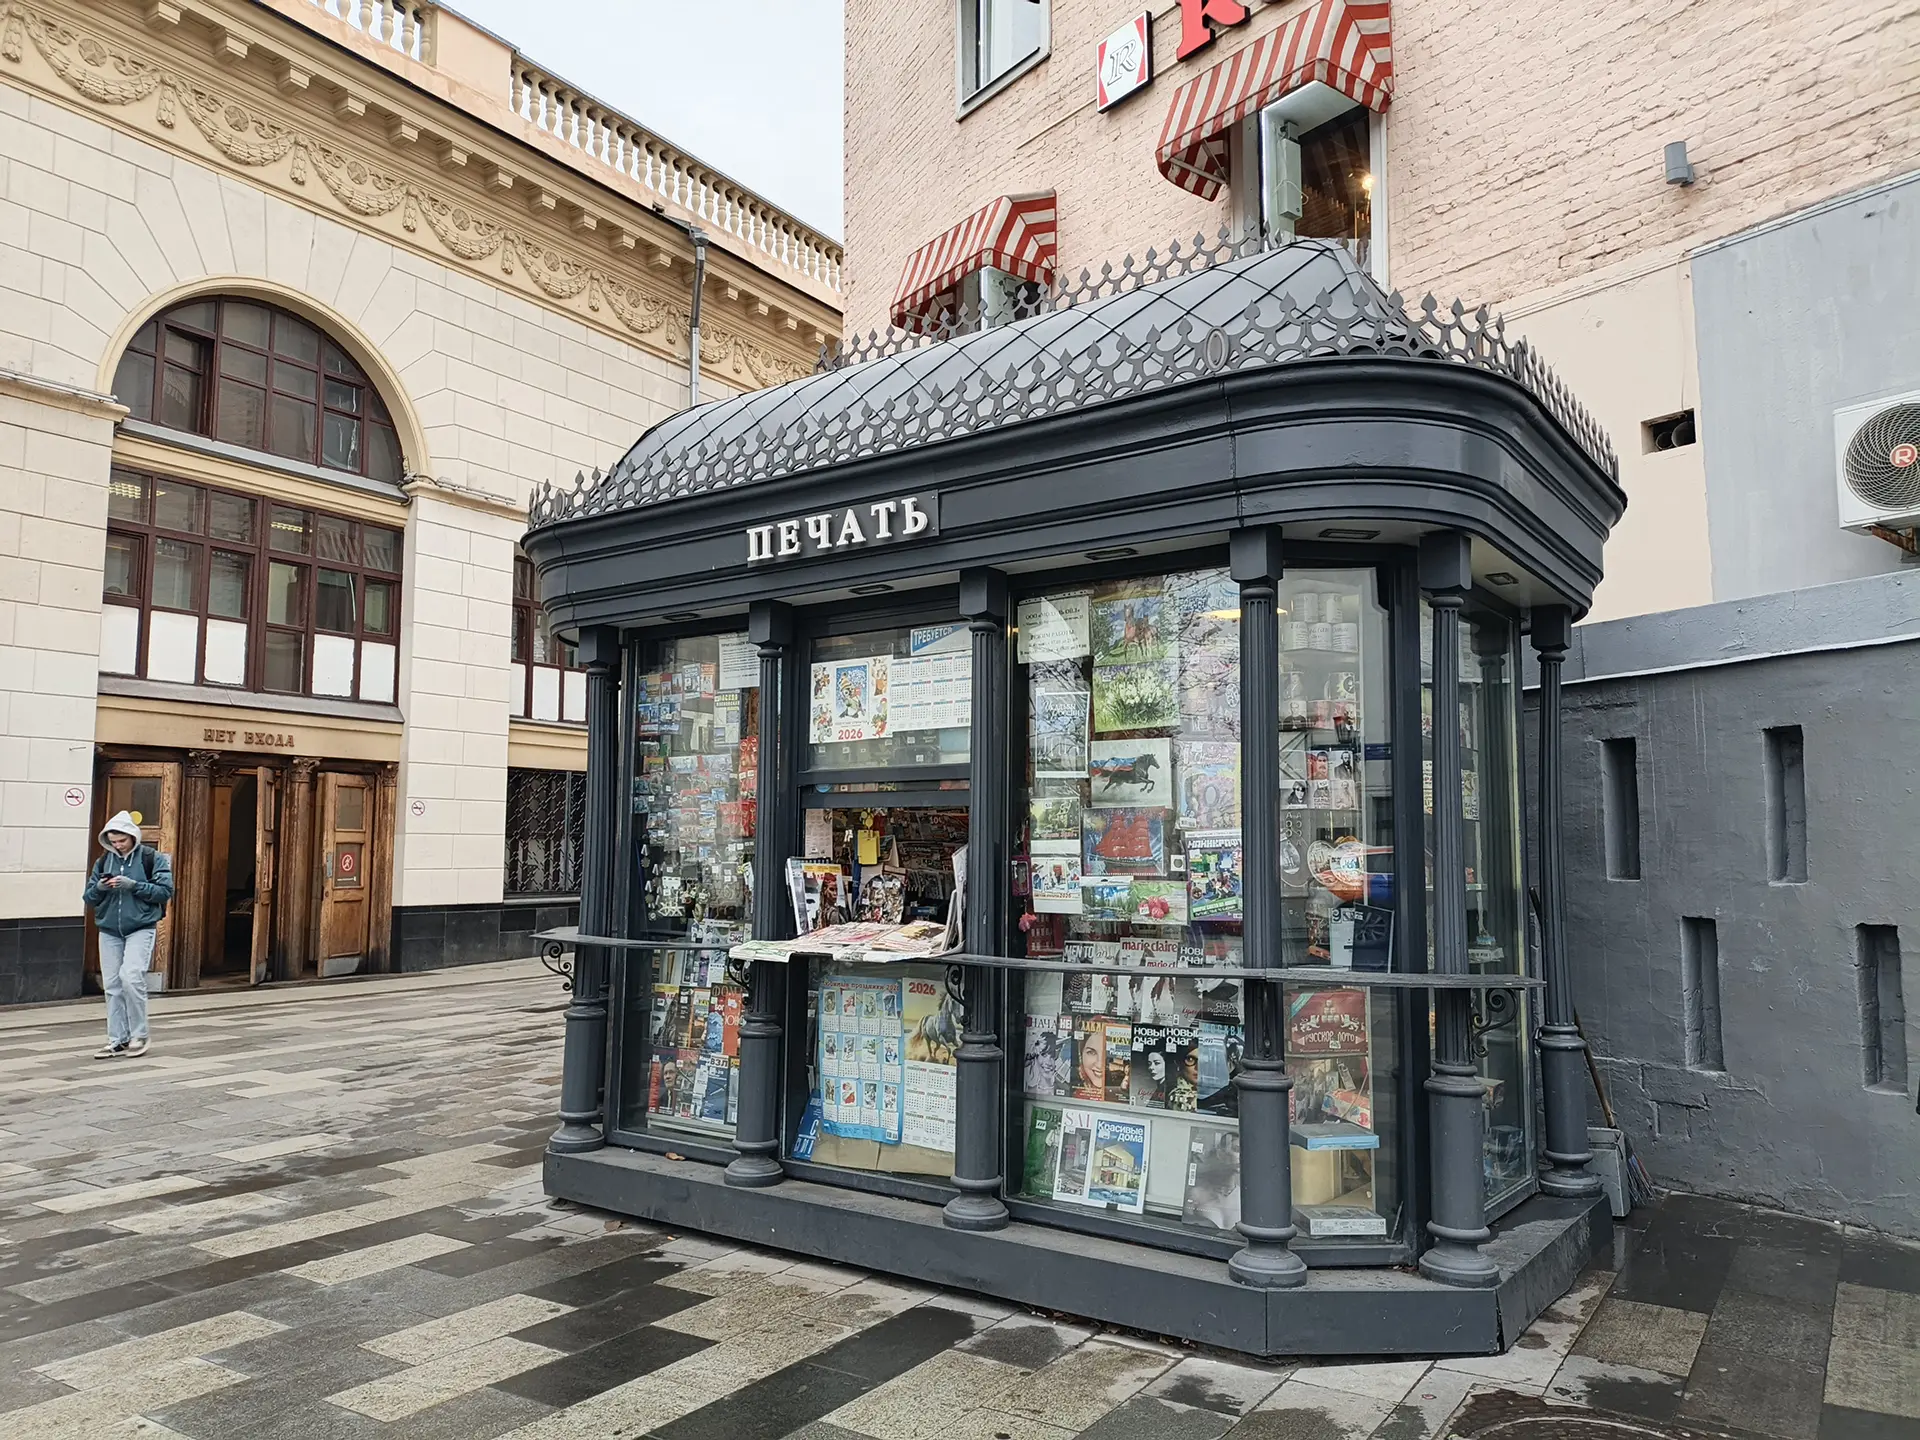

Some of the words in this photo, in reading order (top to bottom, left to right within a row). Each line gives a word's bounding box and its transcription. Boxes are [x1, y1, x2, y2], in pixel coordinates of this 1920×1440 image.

[1895, 449, 1912, 464] R
[746, 497, 928, 561] ПЕЧАТЬ
[914, 626, 953, 646] ТРЕБУЕТСЯ
[203, 728, 237, 744] НЕТ
[244, 731, 295, 748] ВХОДА
[838, 728, 864, 740] 2026
[1122, 940, 1148, 952] marie
[1151, 940, 1178, 953] claire
[908, 982, 937, 995] 2026
[1097, 1120, 1144, 1136] Красивые
[1117, 1133, 1143, 1143] дома
